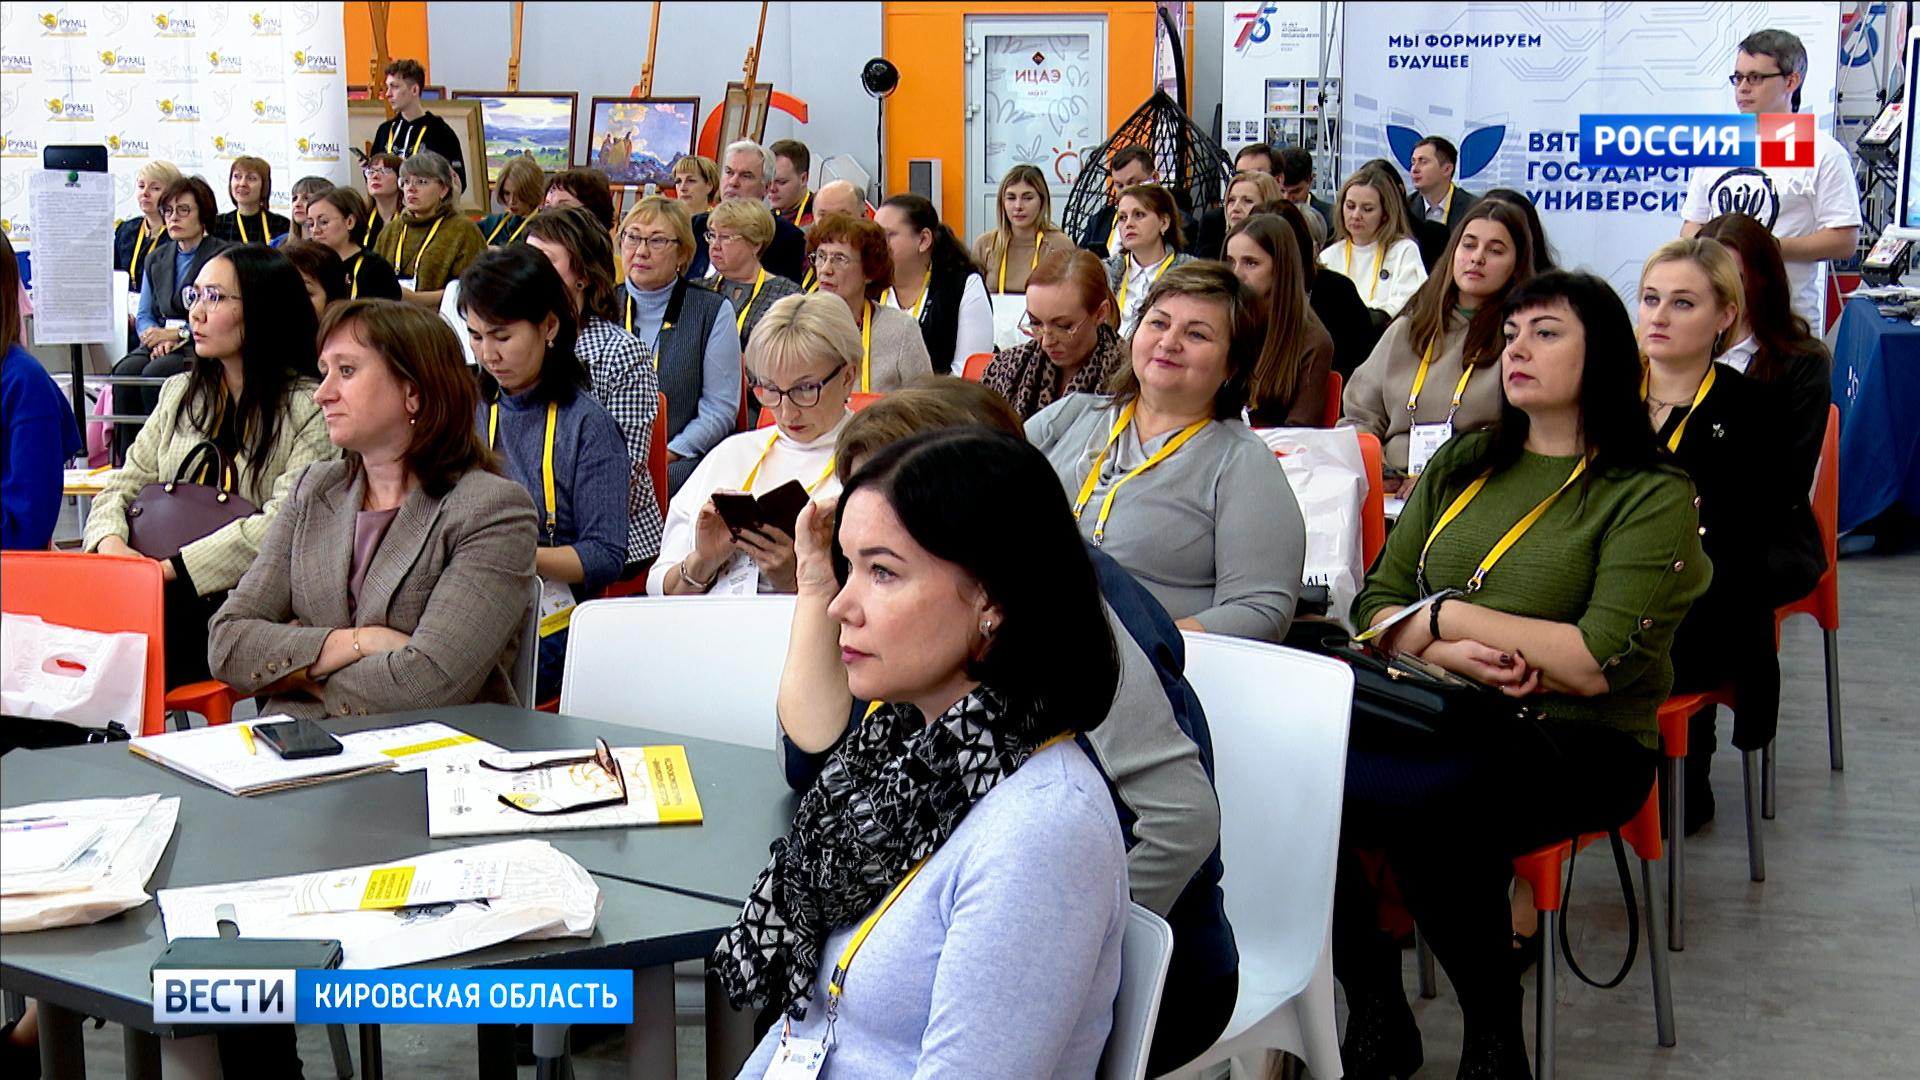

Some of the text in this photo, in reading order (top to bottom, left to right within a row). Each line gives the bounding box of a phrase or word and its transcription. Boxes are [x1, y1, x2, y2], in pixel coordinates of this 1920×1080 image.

[1388, 33, 1542, 48] МЫ ФОРМИРУЕМ
[307, 55, 337, 66] РУМЦ
[1388, 54, 1470, 70] БУДУЩЕЕ
[1015, 69, 1061, 85] ИЦАЭ
[65, 103, 94, 114] РУМЦ
[311, 143, 340, 152] РУМЦ
[1528, 132, 1580, 152] ВЯТ
[1527, 161, 1690, 184] ГОСУДАРСТ
